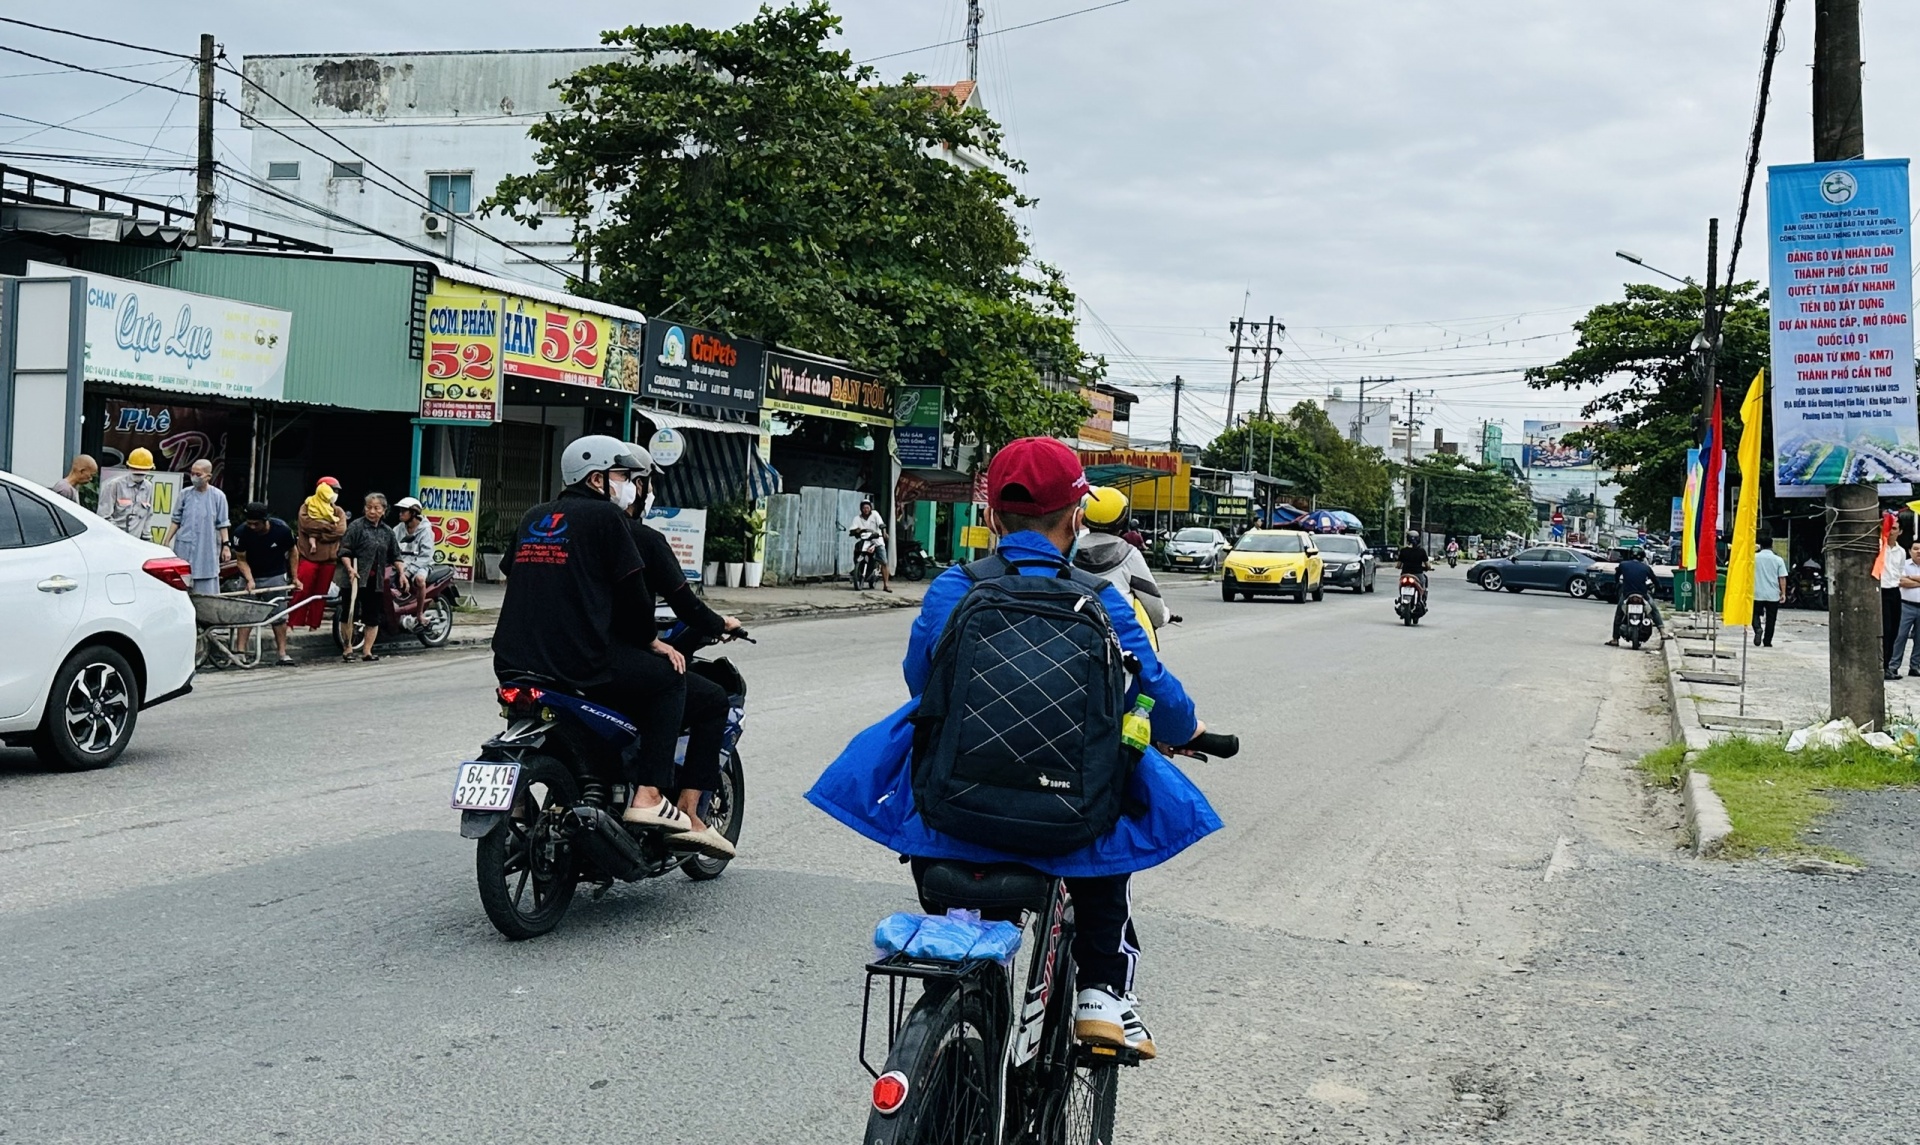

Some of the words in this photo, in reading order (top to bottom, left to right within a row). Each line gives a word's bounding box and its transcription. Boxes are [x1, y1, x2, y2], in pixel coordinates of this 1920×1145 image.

[1787, 250, 1813, 262] ĐẢNG
[1816, 250, 1828, 262] BỘ
[1832, 248, 1842, 260] VÀ
[1845, 246, 1871, 259] NHÂN
[1874, 245, 1894, 257] DÂN
[1794, 266, 1824, 280] THÀNH
[1828, 263, 1846, 278] PHỐ
[1871, 262, 1888, 274] THƠ
[1788, 282, 1817, 297] QUYẾT
[1820, 282, 1840, 294] TÂM
[1862, 280, 1895, 292] NHANH
[88, 288, 117, 310] CHAY
[1800, 300, 1820, 313] TIẾN
[1824, 300, 1836, 312] ĐỘ
[1839, 298, 1856, 311] XÂY
[1859, 298, 1884, 312] DỰNG
[115, 292, 162, 363] Cực
[165, 304, 212, 370] Lạc
[430, 306, 458, 336] CƠM
[1779, 319, 1792, 332] DỰ
[1794, 318, 1808, 330] ÁN
[1810, 317, 1836, 330] NÂNG
[1863, 314, 1878, 326] MỞ
[1880, 314, 1906, 328] RỘNG
[541, 310, 598, 369] 52
[1817, 332, 1842, 346] QUỐC
[1844, 332, 1855, 346] LỘ
[1858, 333, 1868, 344] 91
[427, 342, 494, 380] 52
[1794, 352, 1824, 366] (ĐOẠN
[1826, 350, 1838, 362] TỪ
[1870, 350, 1894, 360] KM7)
[1797, 368, 1828, 381] THÀNH
[1831, 365, 1848, 380] PHỐ
[1852, 365, 1871, 378] CẦN
[1874, 366, 1892, 378] THƠ
[781, 366, 794, 395] Vịt
[795, 367, 811, 394] nấu
[812, 374, 830, 398] chao
[831, 375, 860, 409] BẠN
[863, 378, 885, 410] TÔI
[116, 407, 170, 432] Phê
[432, 408, 454, 418] 0919
[456, 410, 472, 418] 021
[474, 410, 492, 420] 552
[1126, 451, 1148, 469] CÔNG
[420, 486, 442, 510] CƠM
[426, 516, 472, 548] 52
[580, 704, 624, 725] EXCITER
[456, 786, 510, 806] 327.57
